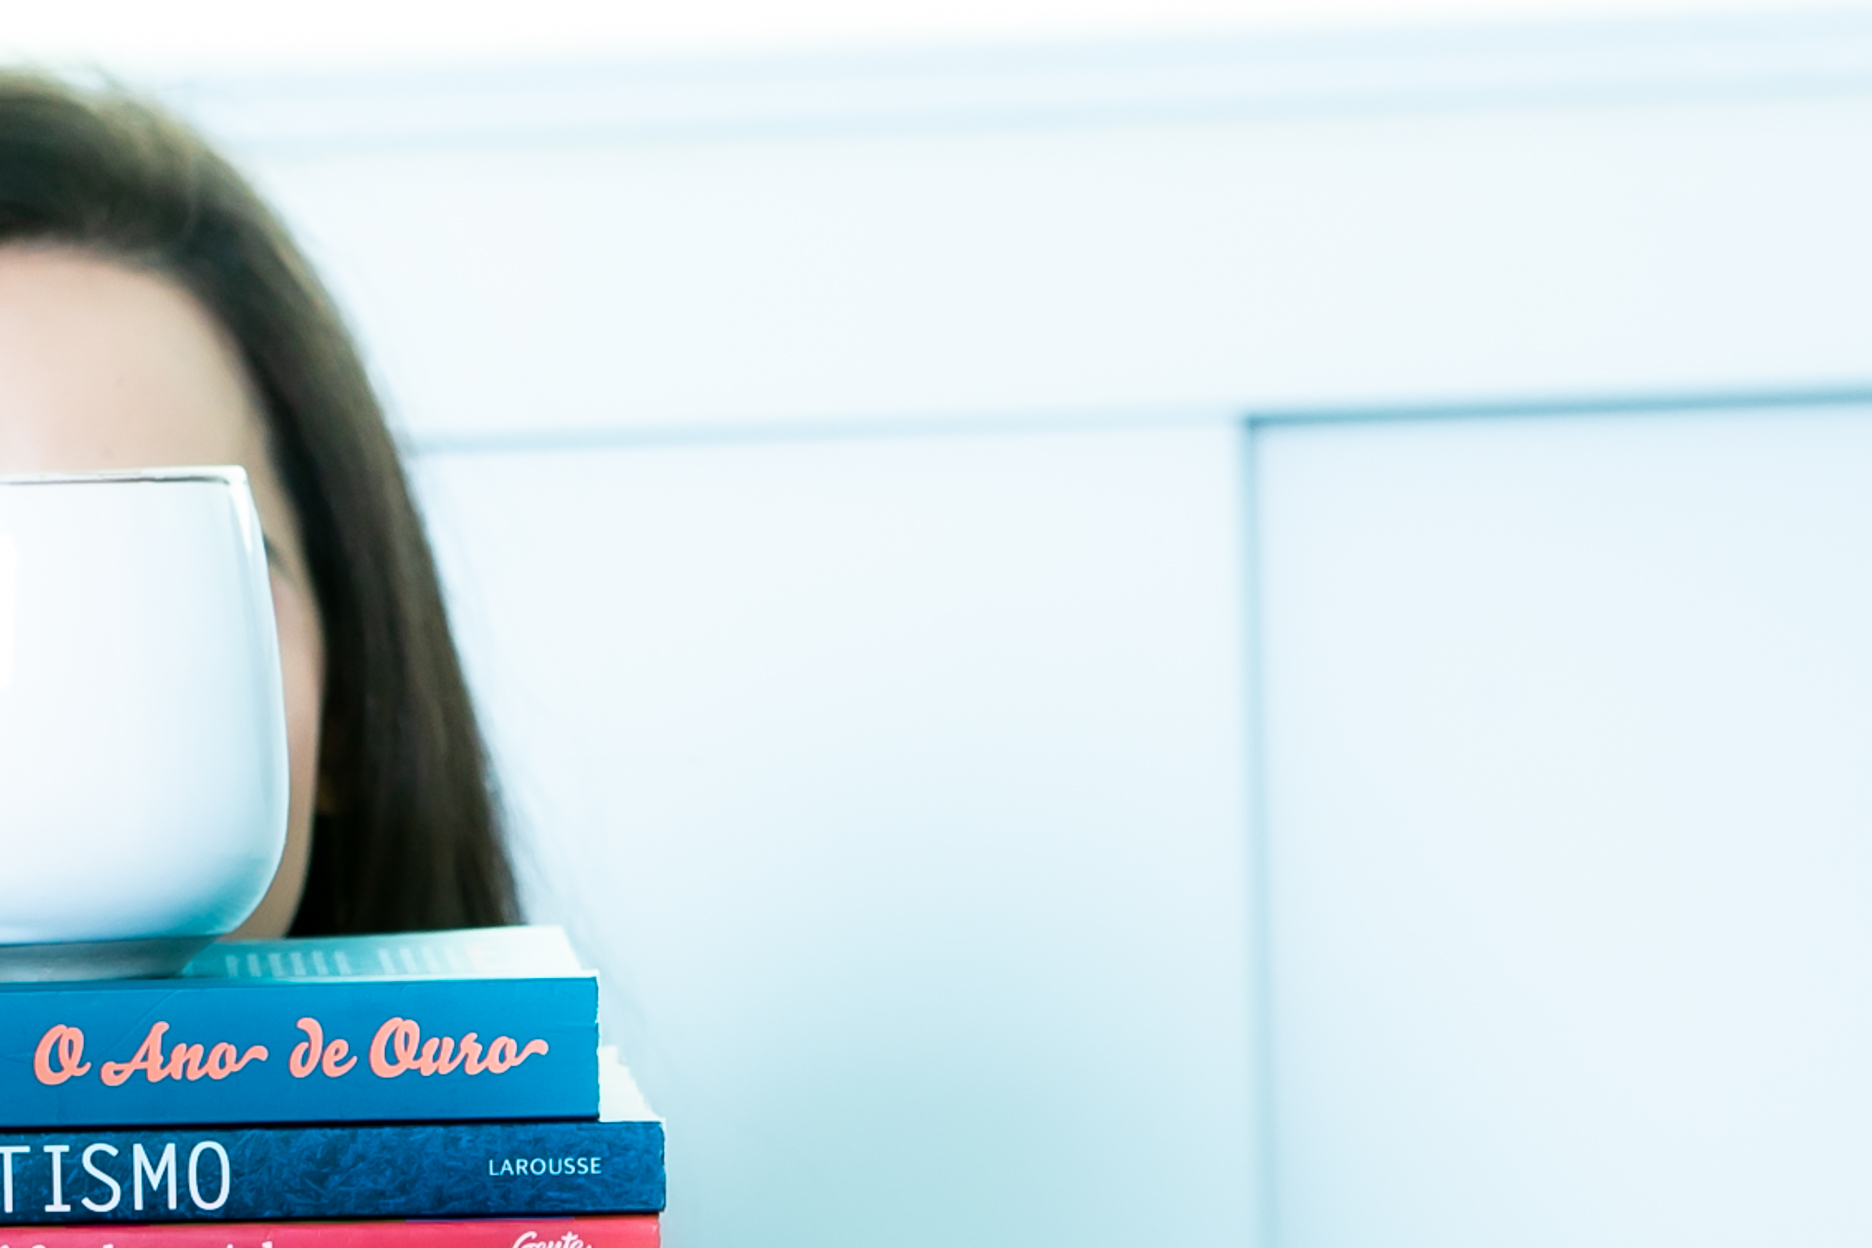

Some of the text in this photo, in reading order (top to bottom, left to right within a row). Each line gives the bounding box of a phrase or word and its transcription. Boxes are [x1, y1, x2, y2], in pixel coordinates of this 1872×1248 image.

[33, 1016, 549, 1087] O Ano de Ouro
[488, 1157, 603, 1177] LAROUSSE
